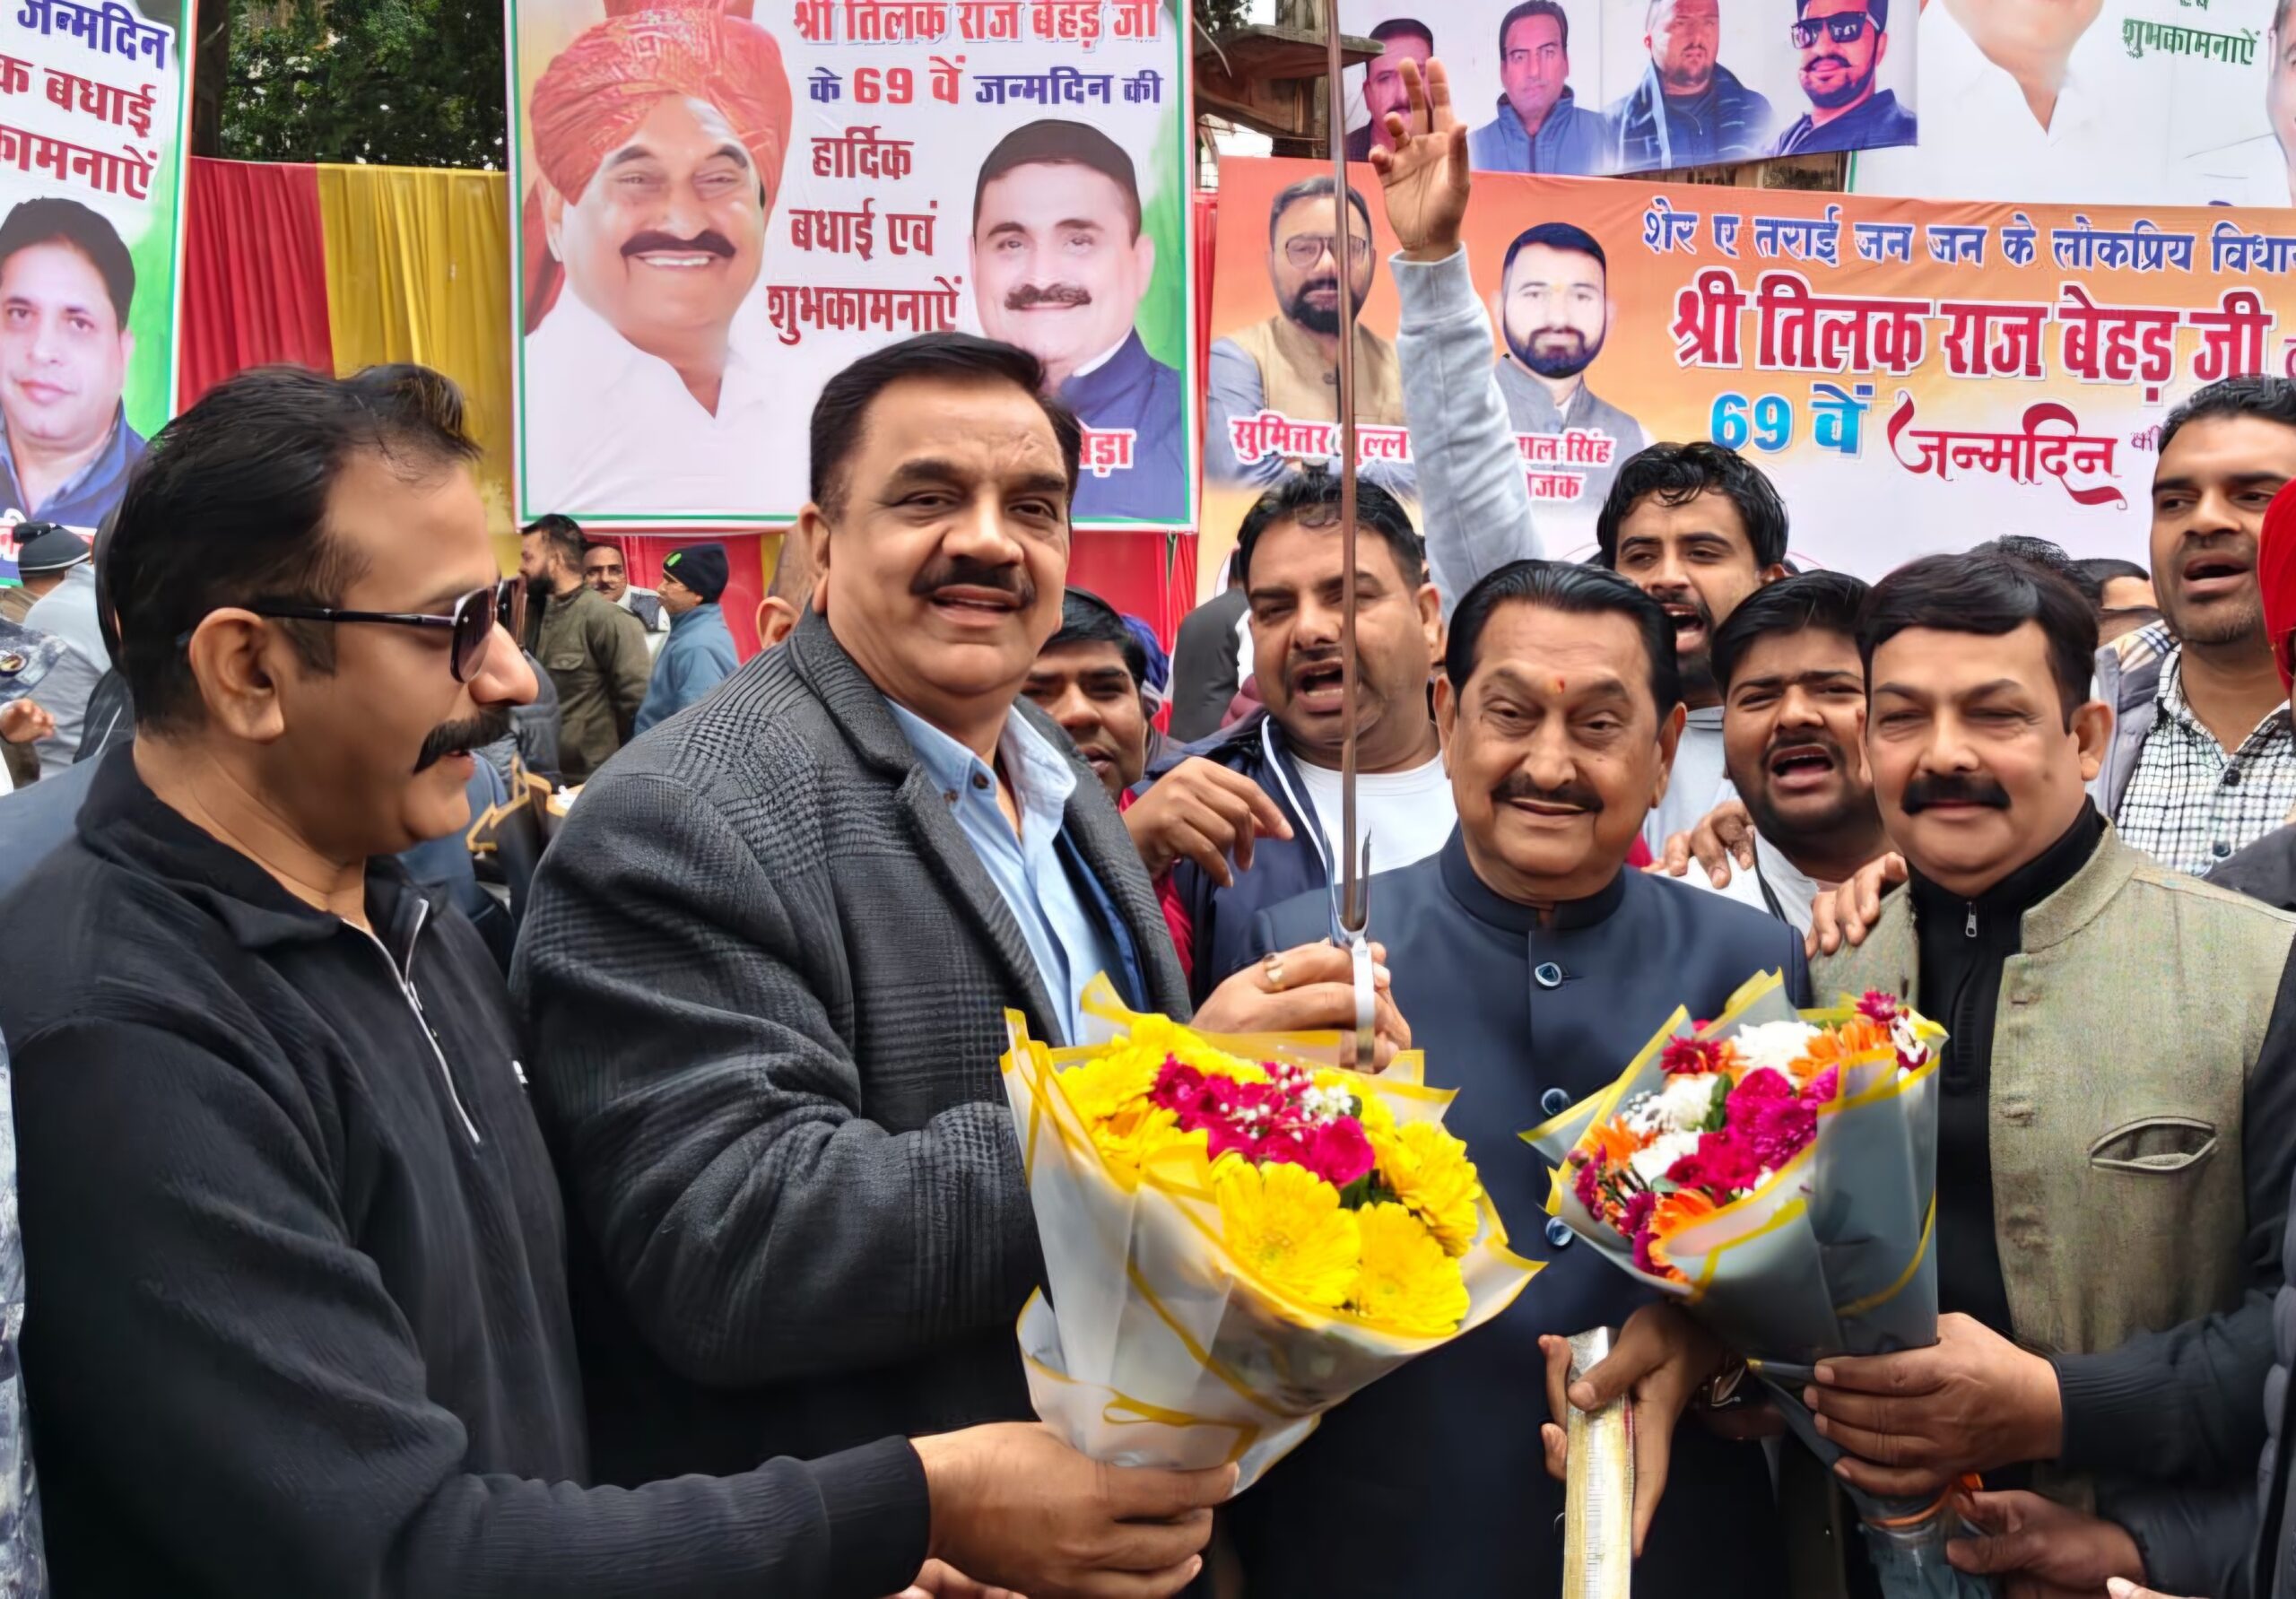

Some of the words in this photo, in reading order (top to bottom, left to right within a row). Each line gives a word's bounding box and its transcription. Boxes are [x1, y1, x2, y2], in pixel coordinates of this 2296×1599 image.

[17, 0, 170, 70] जन्मदिन
[845, 0, 949, 41] तिलक
[957, 0, 1022, 39] राज
[1031, 0, 1103, 48] बहड़
[44, 67, 157, 138] बधाई
[808, 65, 842, 104] के
[854, 67, 913, 105] 69
[929, 55, 967, 105] वें
[973, 65, 1115, 106] जन्मदिन
[1121, 69, 1164, 105] की
[811, 126, 915, 180] हार्दिक
[788, 197, 876, 262] बधाई
[885, 200, 938, 256] एवं
[1645, 197, 1699, 254] शेर
[1713, 214, 1740, 256] ए
[1754, 205, 1843, 265] तराई
[1855, 223, 1914, 262] जन
[1927, 225, 1987, 265] जन
[2002, 213, 2036, 266] के
[2053, 215, 2196, 271] लोकप्रिय
[766, 275, 962, 346] शुभकामनाऐं
[1673, 270, 1747, 364] श्री
[1757, 274, 1931, 372] तिलक
[1940, 303, 2048, 377] राज
[2058, 285, 2180, 402] बेहड़
[2190, 291, 2274, 380] जी
[1566, 430, 1613, 463] सिंह
[1711, 393, 1792, 452] 69
[1811, 384, 1871, 455] वें
[1887, 392, 2126, 510] जन्मदिन
